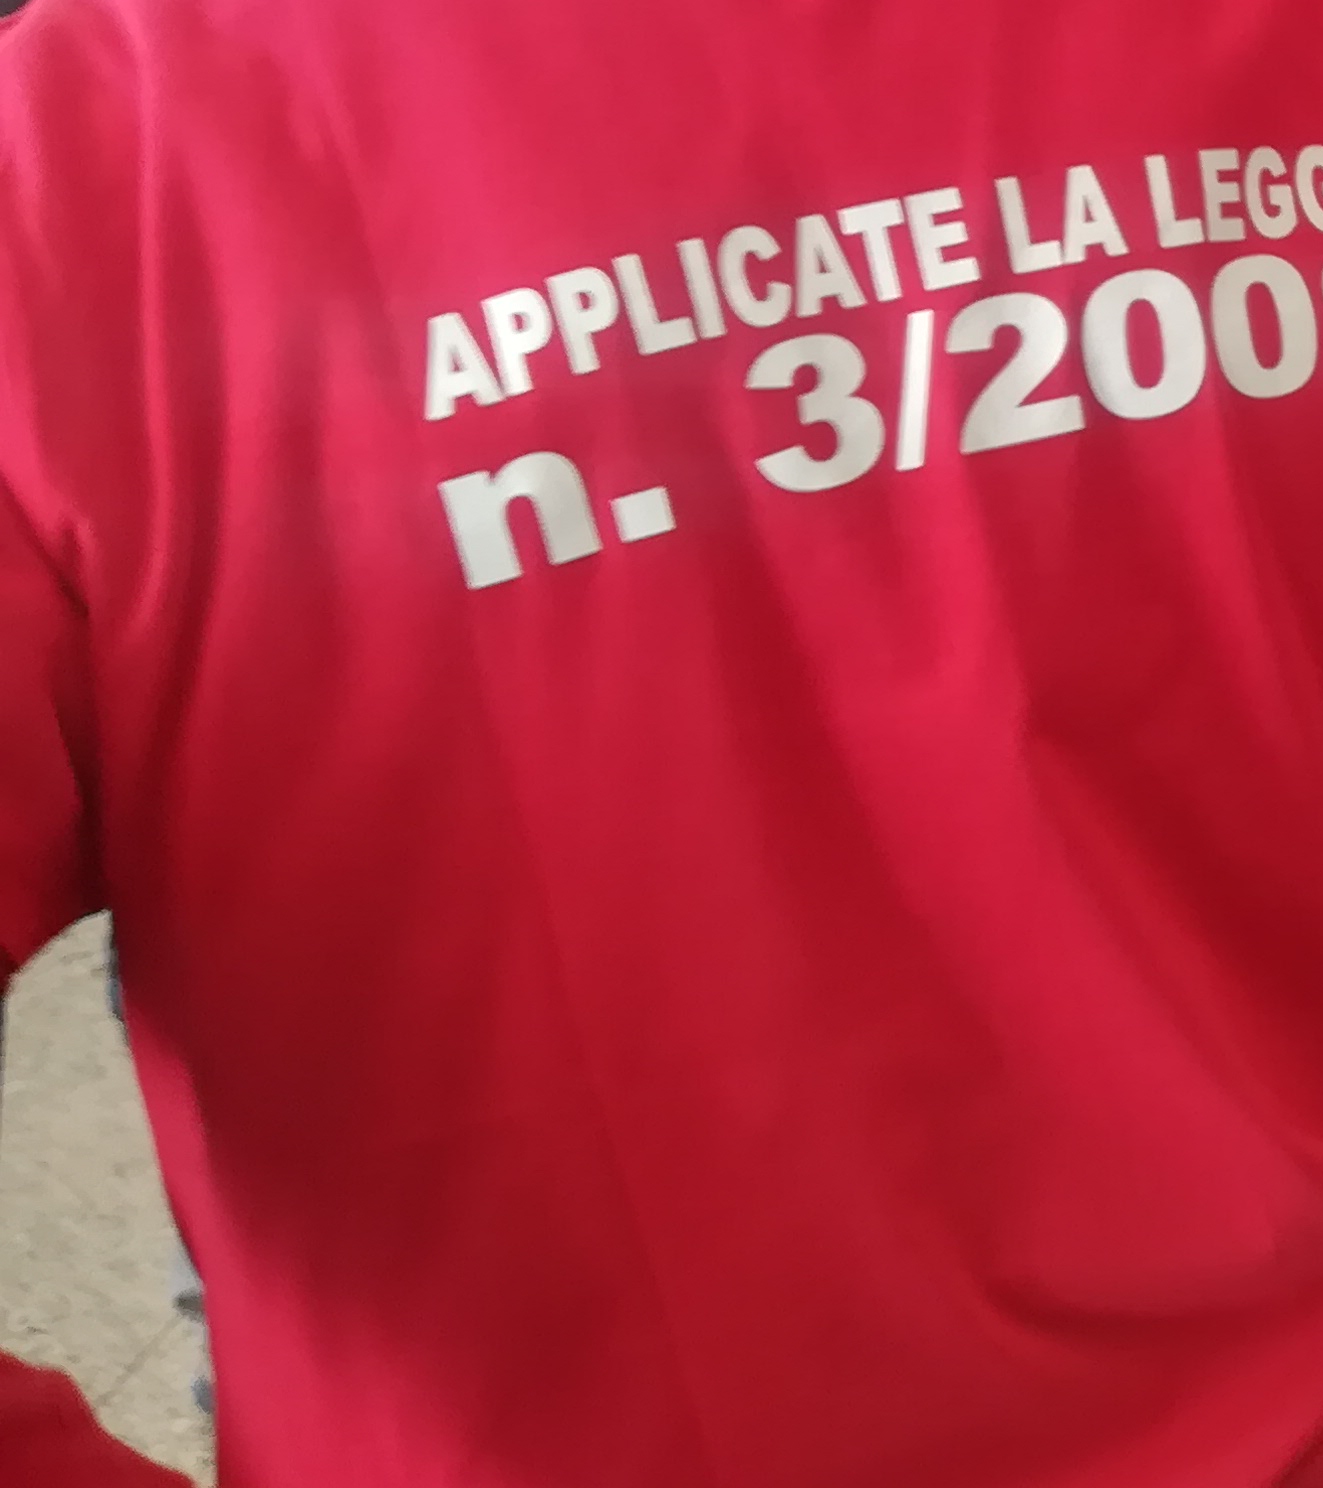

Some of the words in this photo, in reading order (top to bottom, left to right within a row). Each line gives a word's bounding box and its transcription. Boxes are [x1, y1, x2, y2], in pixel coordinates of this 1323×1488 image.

[424, 187, 982, 421] APPLICATE
[996, 165, 1128, 274] LA
[437, 451, 676, 589] n.
